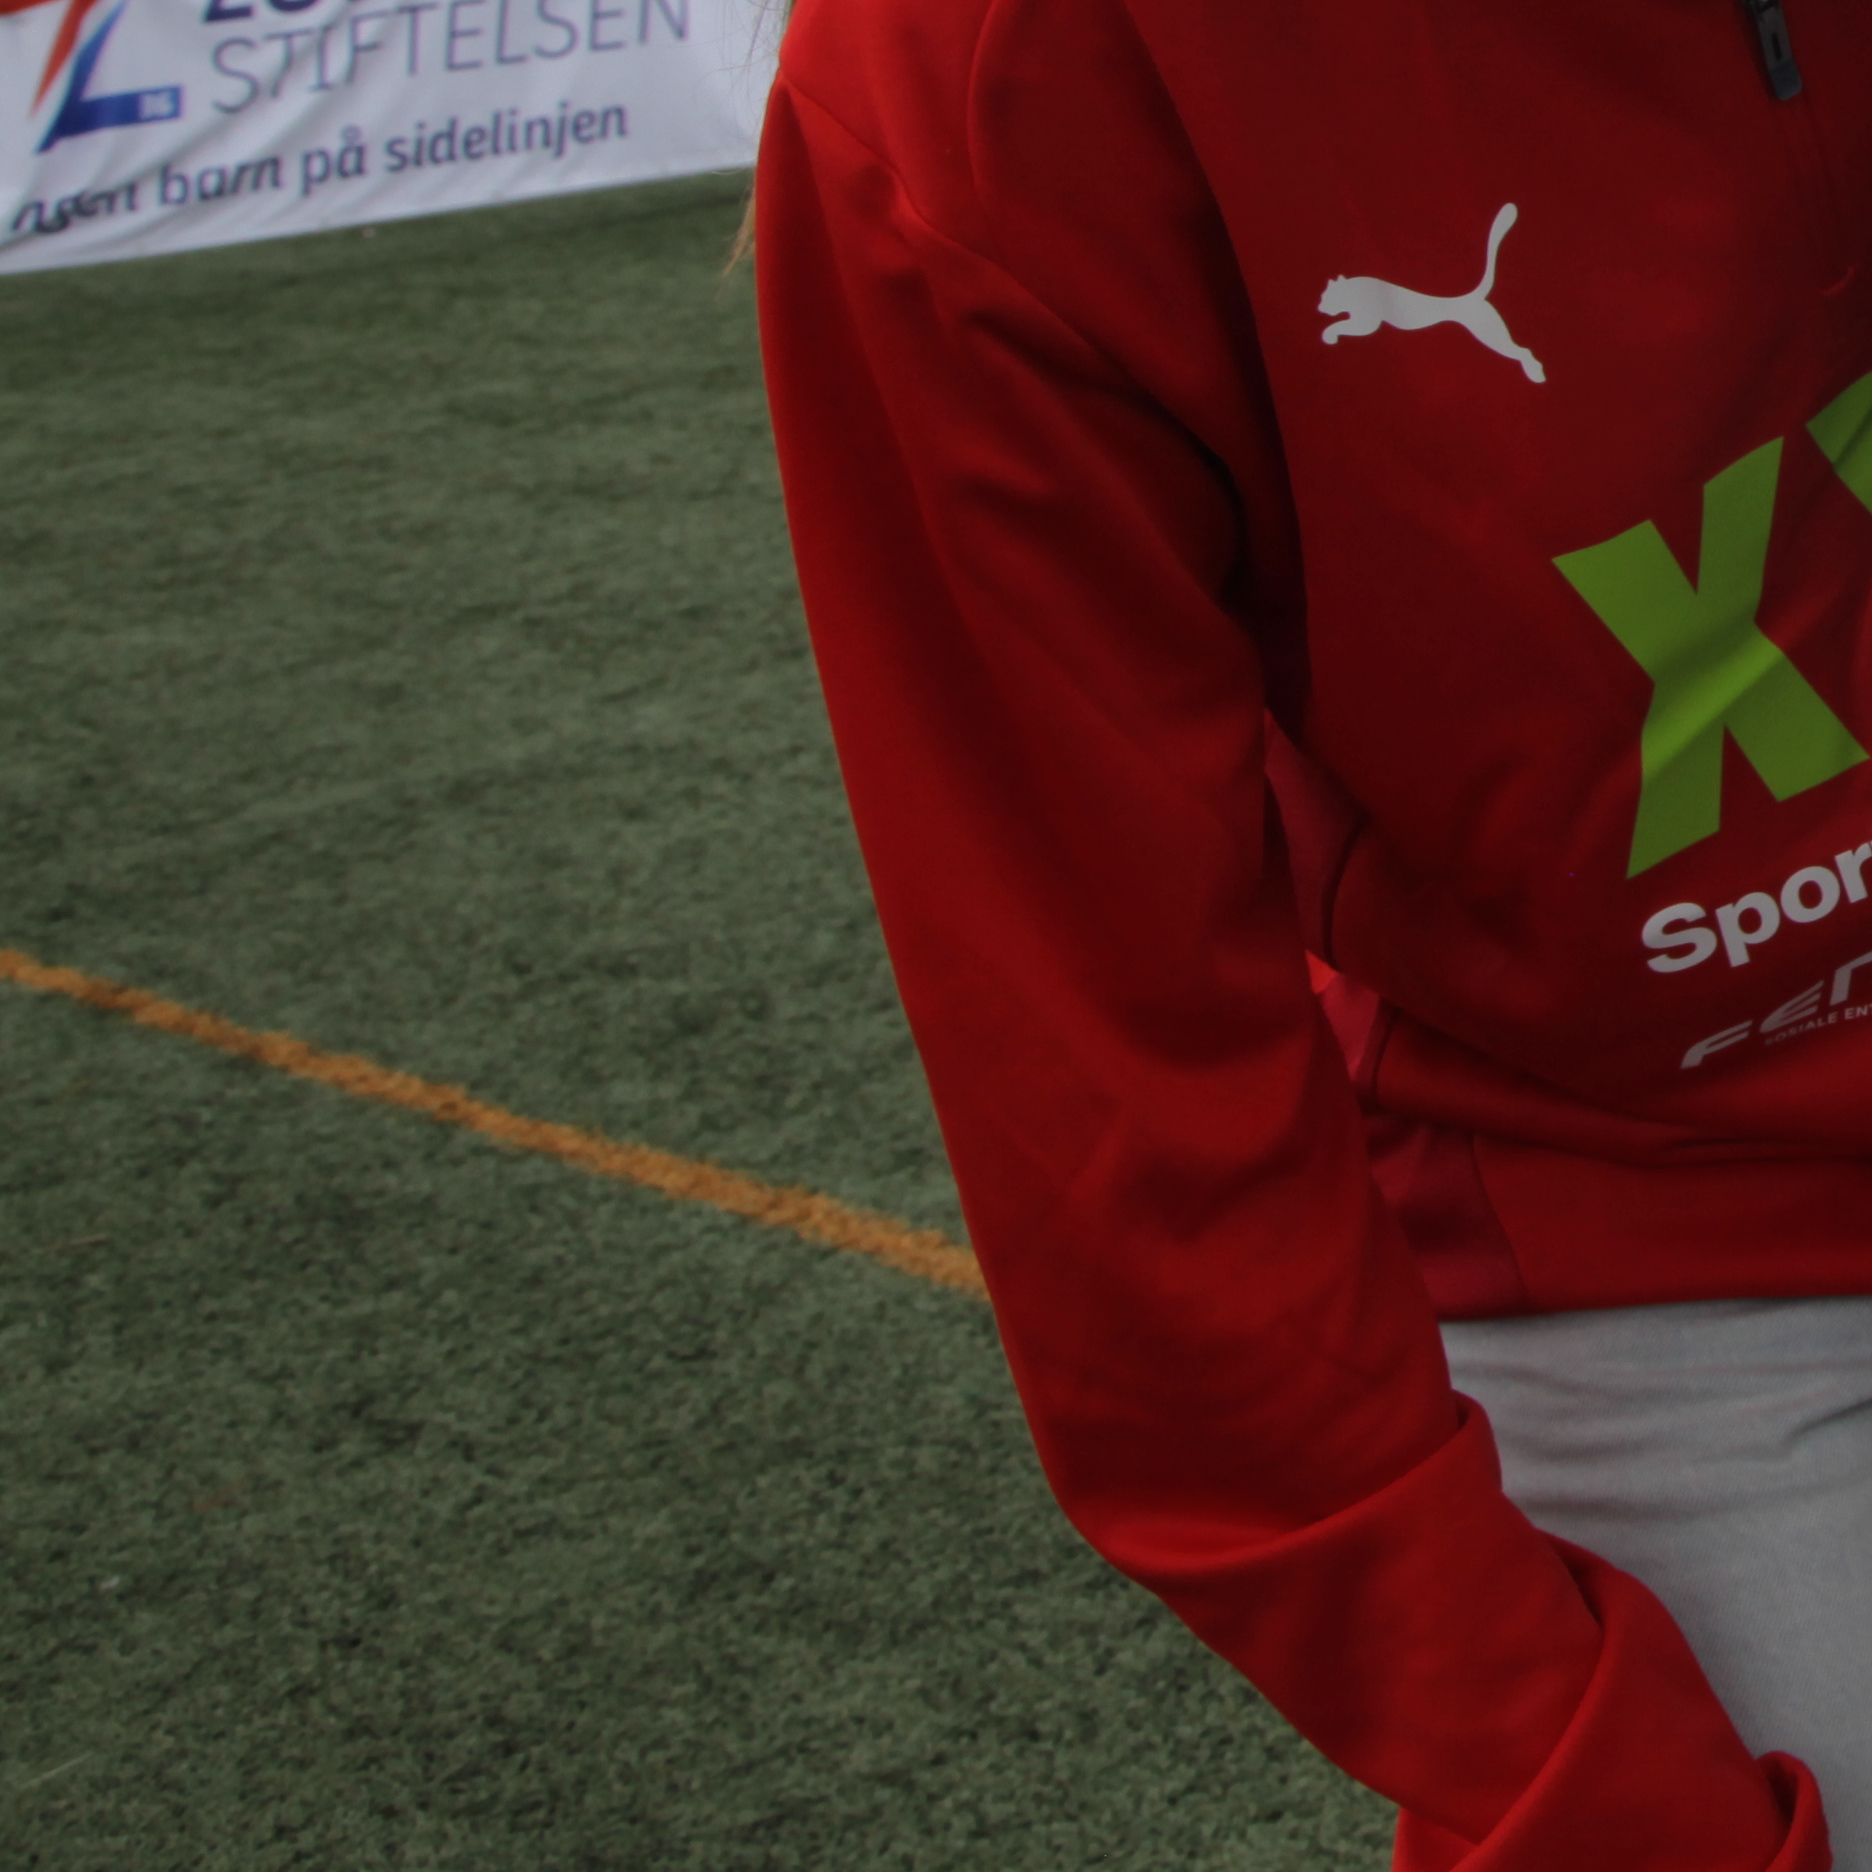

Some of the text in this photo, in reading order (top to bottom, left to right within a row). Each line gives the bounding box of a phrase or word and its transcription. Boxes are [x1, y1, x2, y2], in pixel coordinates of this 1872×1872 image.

[157, 156, 284, 206] barn
[301, 123, 367, 197] på
[383, 99, 629, 173] sidelinjen
[1763, 1010, 1839, 1046] SOSIALE
